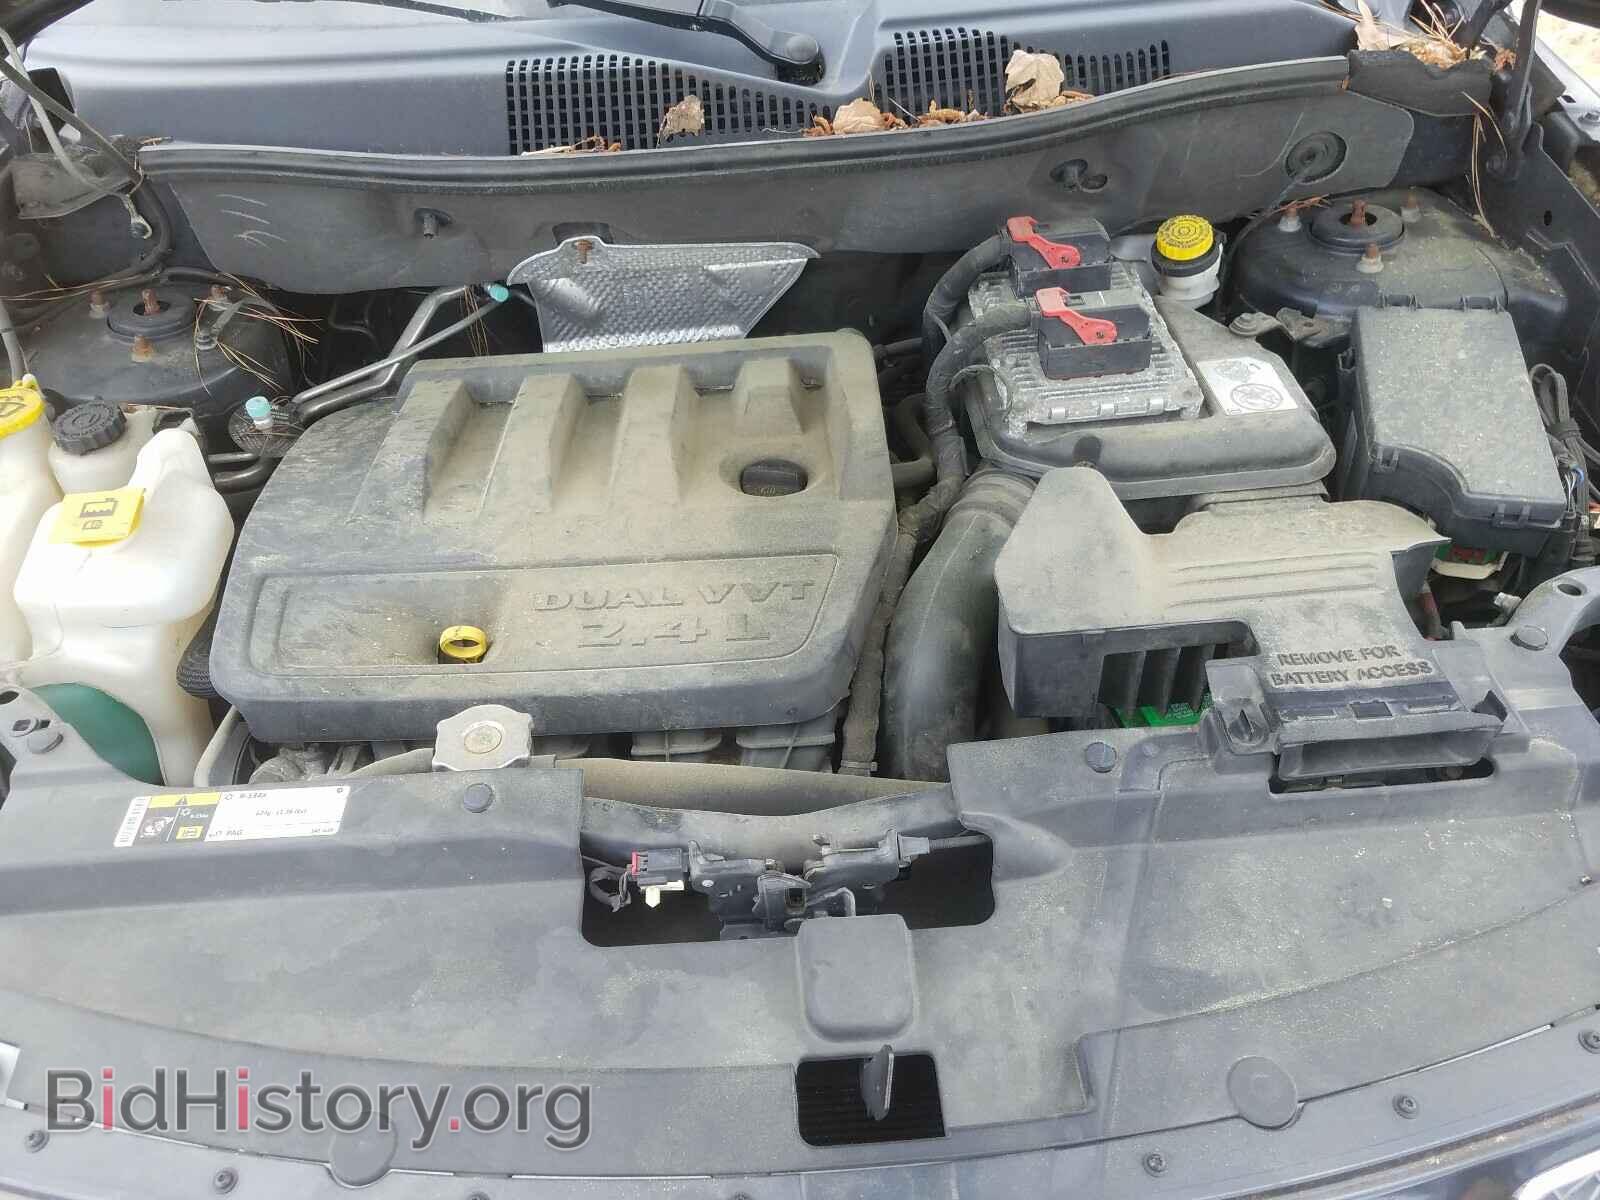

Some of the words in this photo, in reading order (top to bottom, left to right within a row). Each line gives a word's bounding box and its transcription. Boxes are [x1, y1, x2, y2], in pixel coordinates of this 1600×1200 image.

[534, 588, 683, 611] DUAL
[697, 582, 816, 604] VVT
[577, 613, 770, 648] 2.4L
[1276, 649, 1357, 667] REMOVE
[1360, 644, 1401, 660] FOR
[1271, 668, 1352, 686] BATTERY
[1357, 661, 1434, 681] ACCESS
